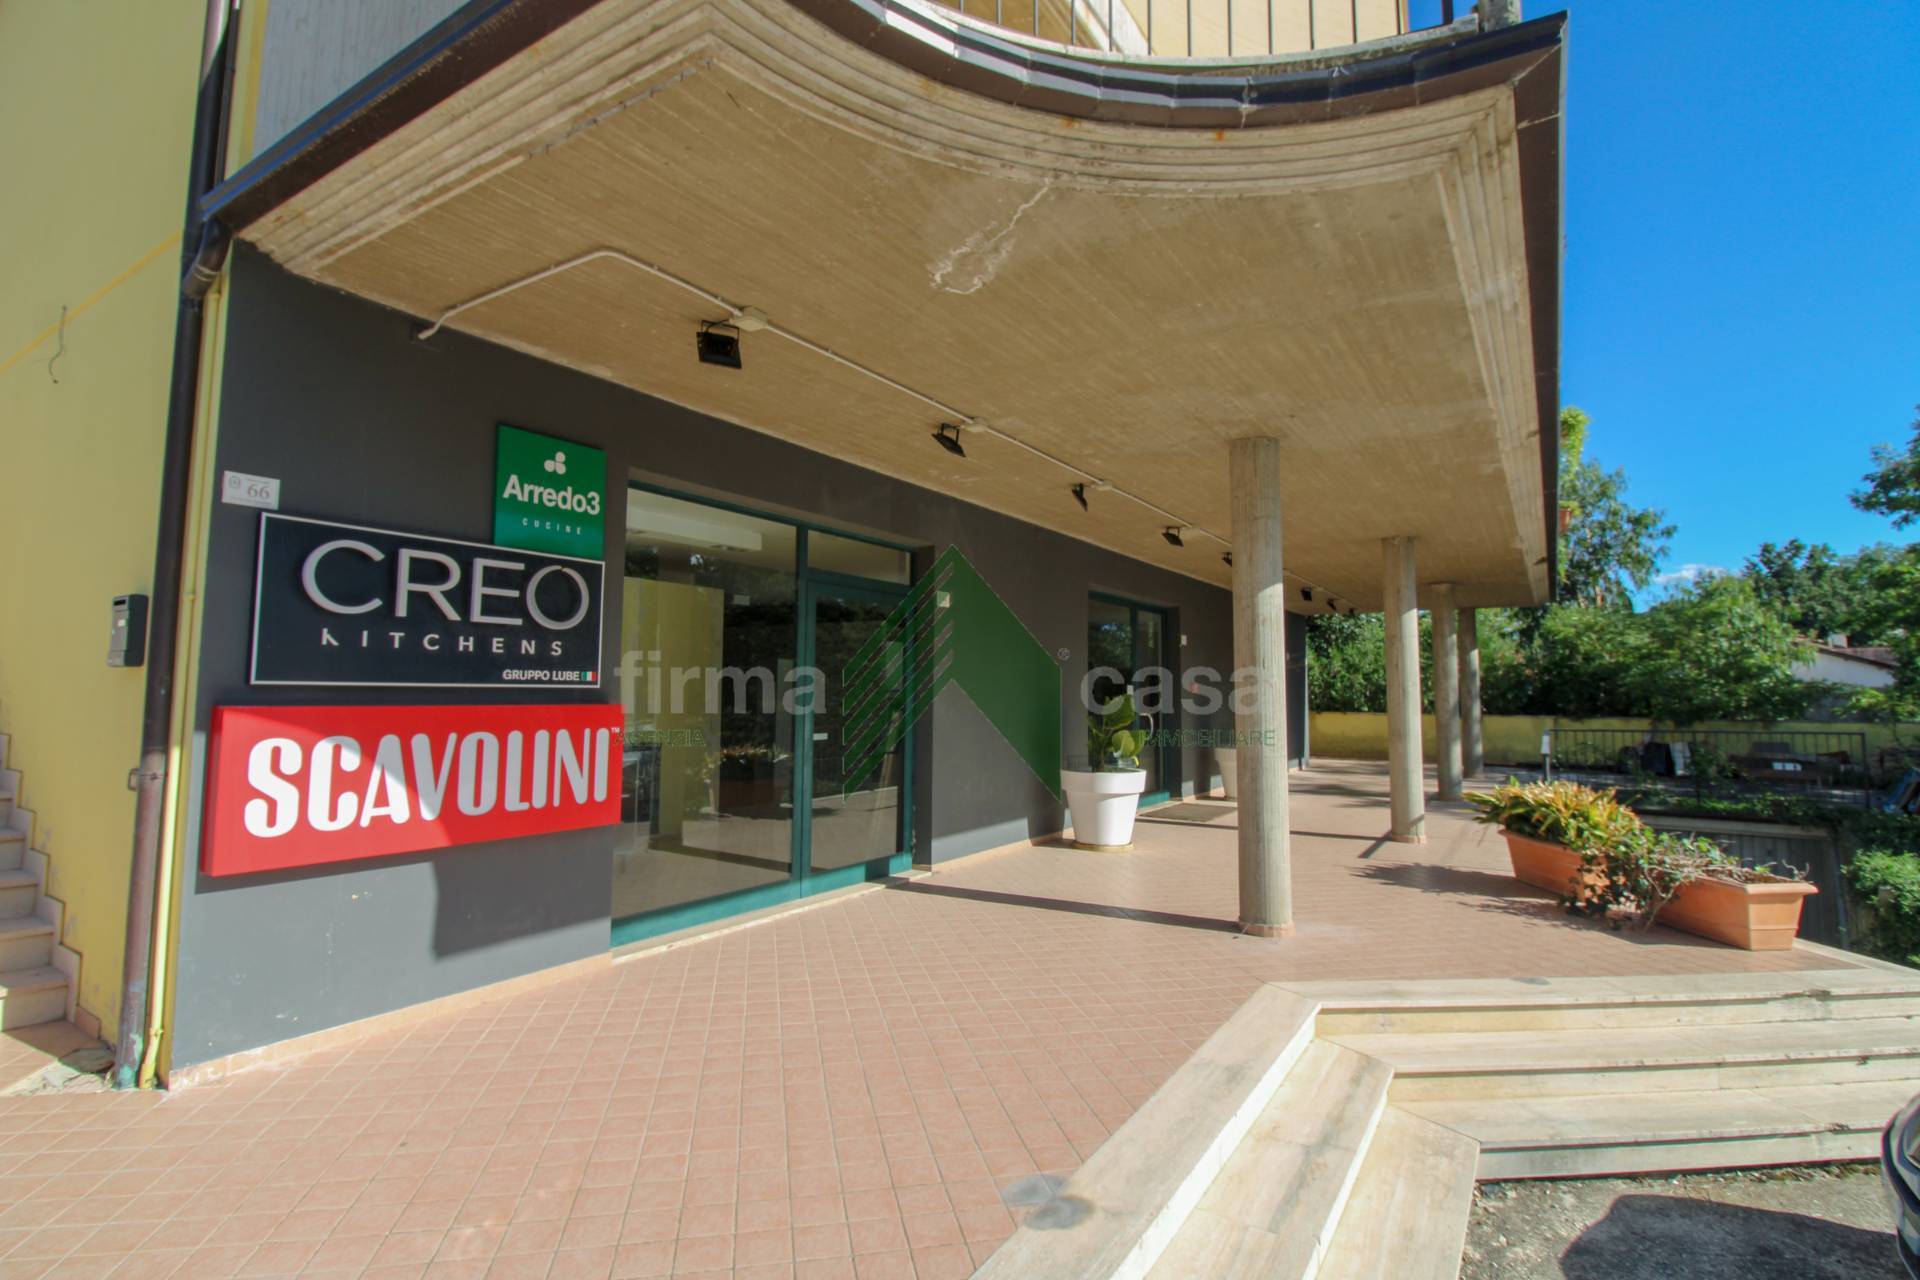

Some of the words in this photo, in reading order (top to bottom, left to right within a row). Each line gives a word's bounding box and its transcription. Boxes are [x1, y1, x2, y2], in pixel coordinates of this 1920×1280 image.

[247, 483, 271, 500] 66
[502, 474, 600, 515] Arredo3
[522, 518, 582, 535] CUCINE
[301, 539, 590, 630] CREO
[320, 627, 563, 656] KITCHENS
[502, 668, 550, 681] GRUPPO
[552, 671, 580, 682] LUBE
[243, 727, 610, 838] SCAVOLINI
